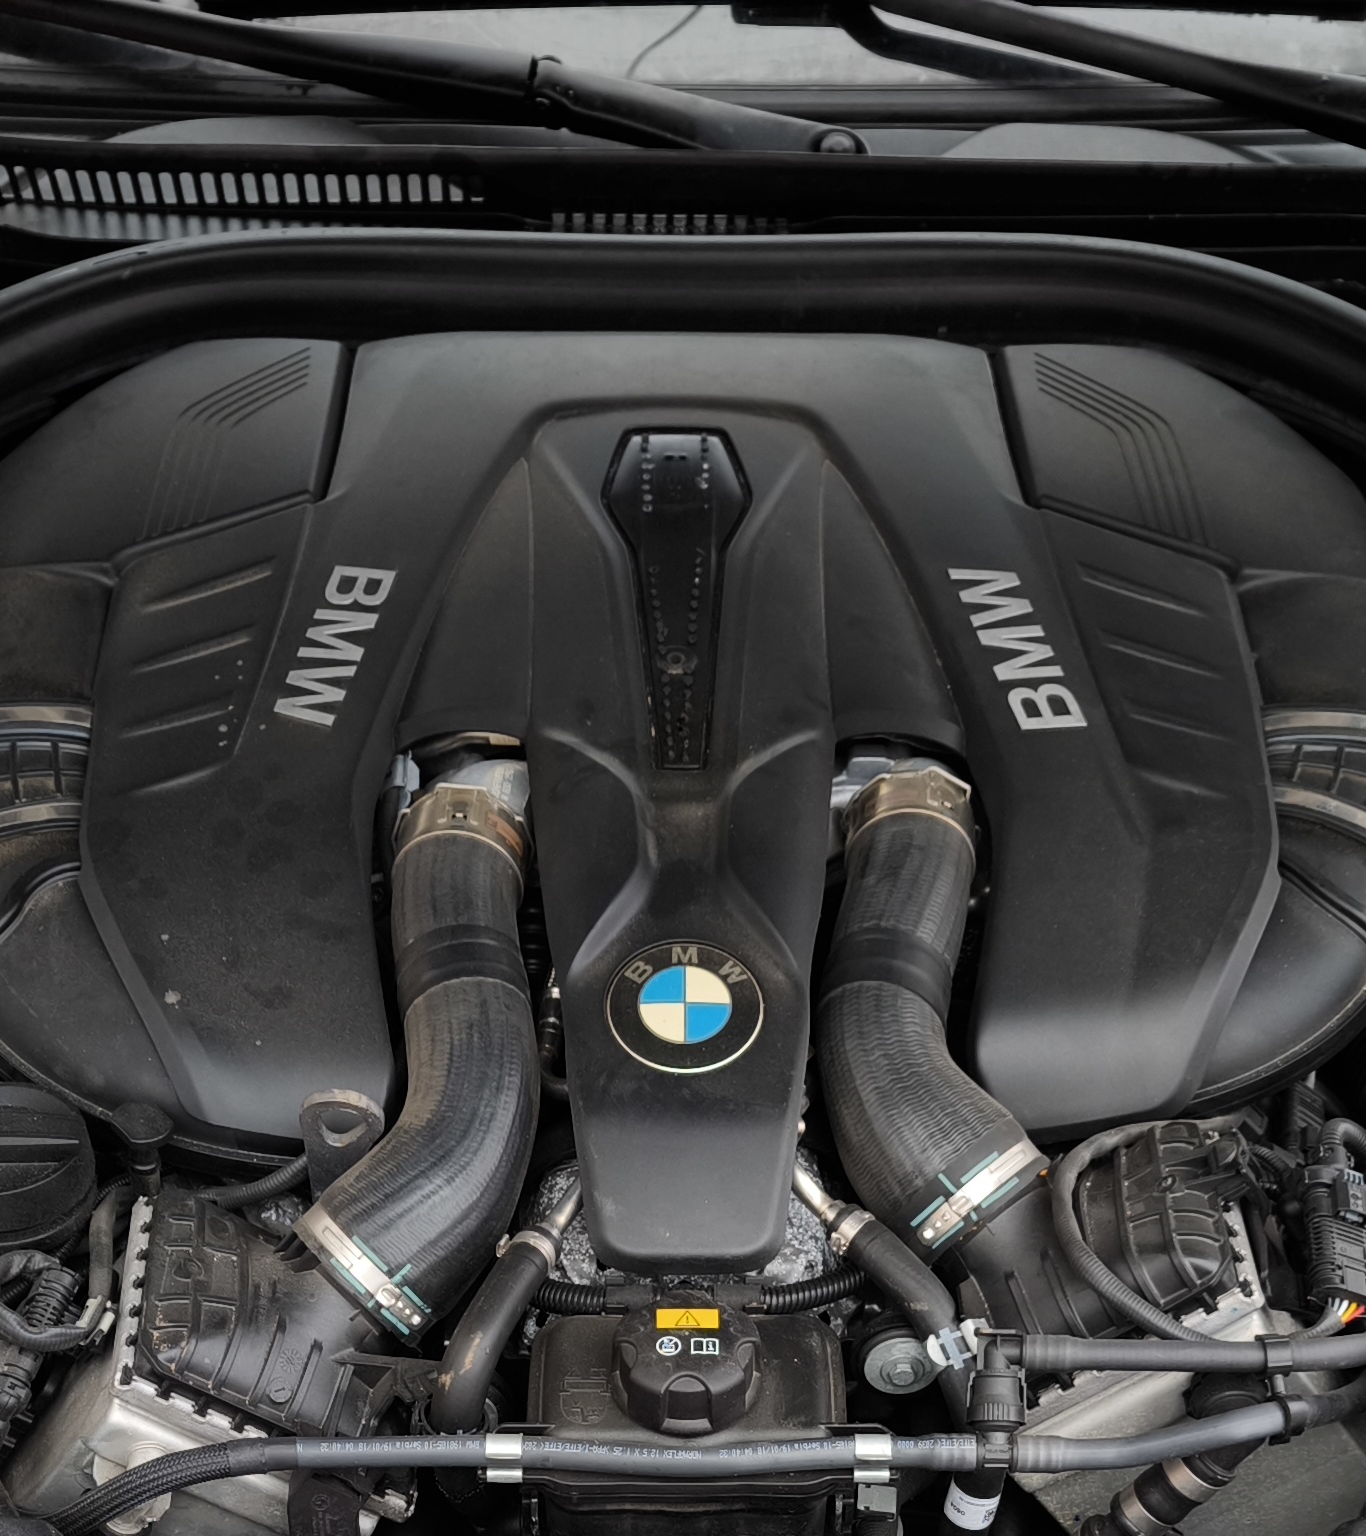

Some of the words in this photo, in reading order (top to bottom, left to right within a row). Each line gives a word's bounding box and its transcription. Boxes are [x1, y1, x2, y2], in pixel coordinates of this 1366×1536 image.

[273, 564, 397, 727] BMW
[947, 568, 1088, 730] BMW
[623, 946, 749, 986] BMW
[395, 1441, 422, 1449] Serbia
[794, 1441, 821, 1450] Serbia
